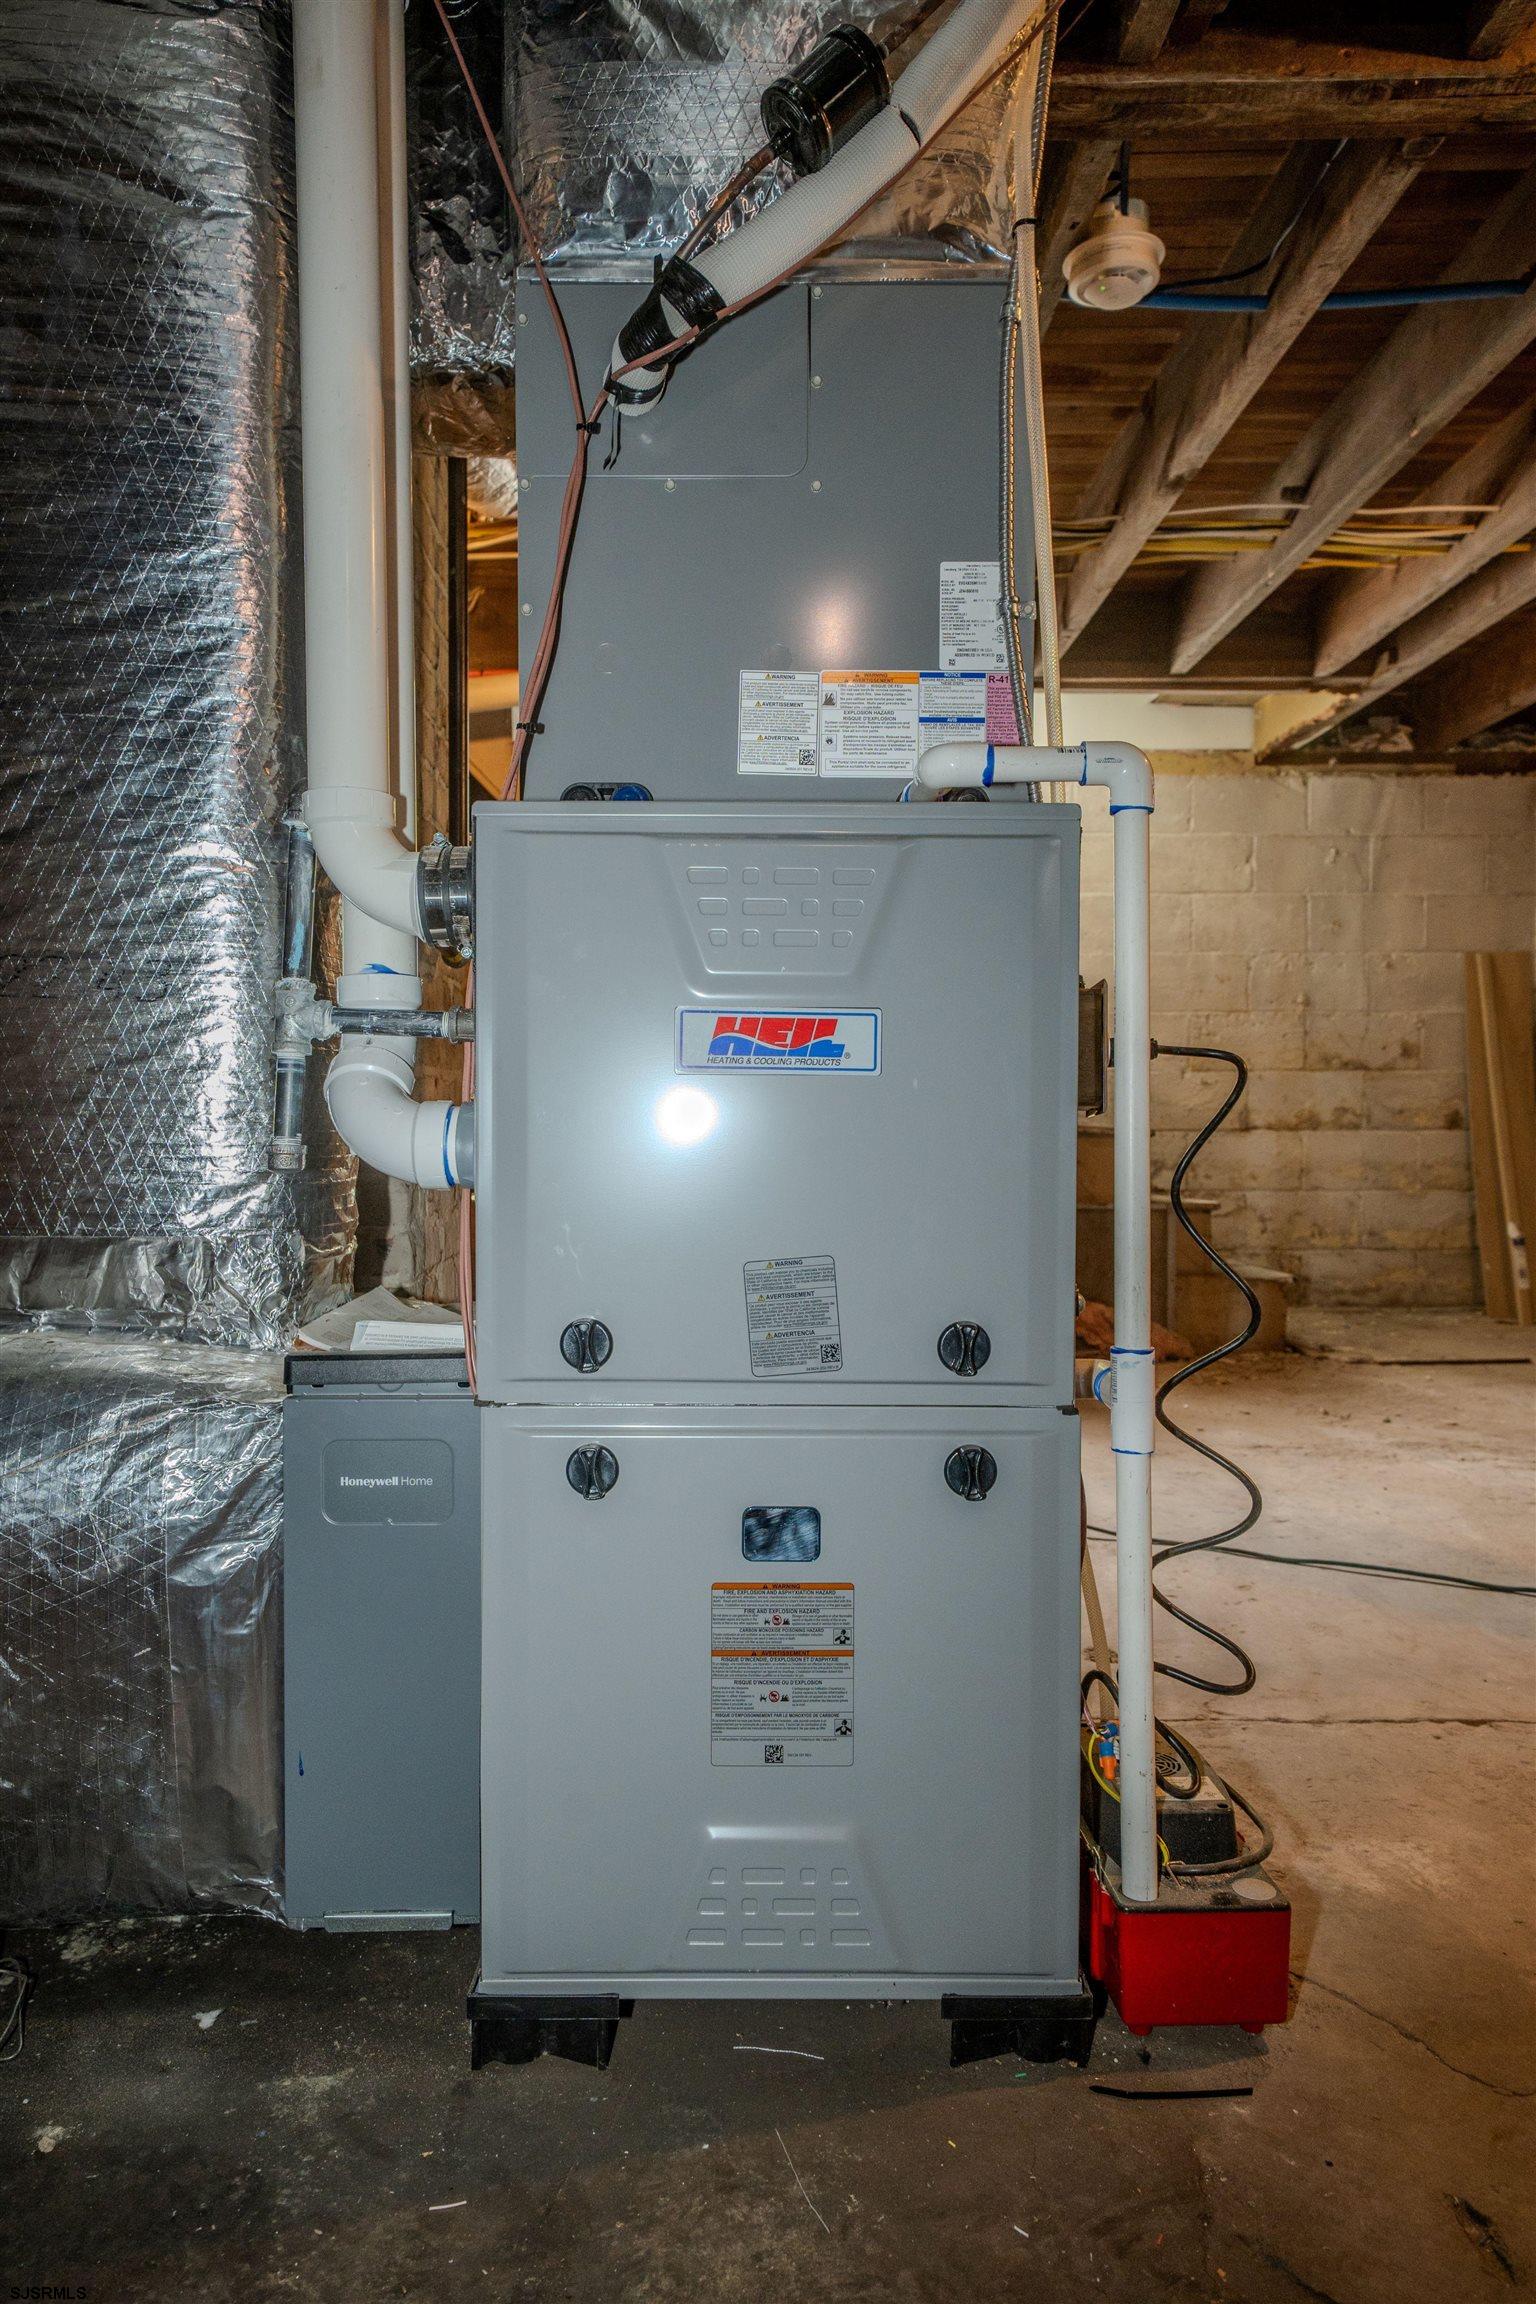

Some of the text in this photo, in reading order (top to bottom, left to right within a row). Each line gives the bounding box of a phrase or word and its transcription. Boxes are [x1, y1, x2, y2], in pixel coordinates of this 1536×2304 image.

[988, 675, 1009, 683] R-41
[708, 1016, 846, 1057] HEIL
[707, 1056, 842, 1067] HEATING & COOLING PRODUCTS
[774, 1259, 803, 1267] WARNING
[765, 1291, 815, 1300] AVERTISSEMENT
[773, 1330, 816, 1338] ADVERTENCIA
[340, 1476, 433, 1488] Honeywell Home
